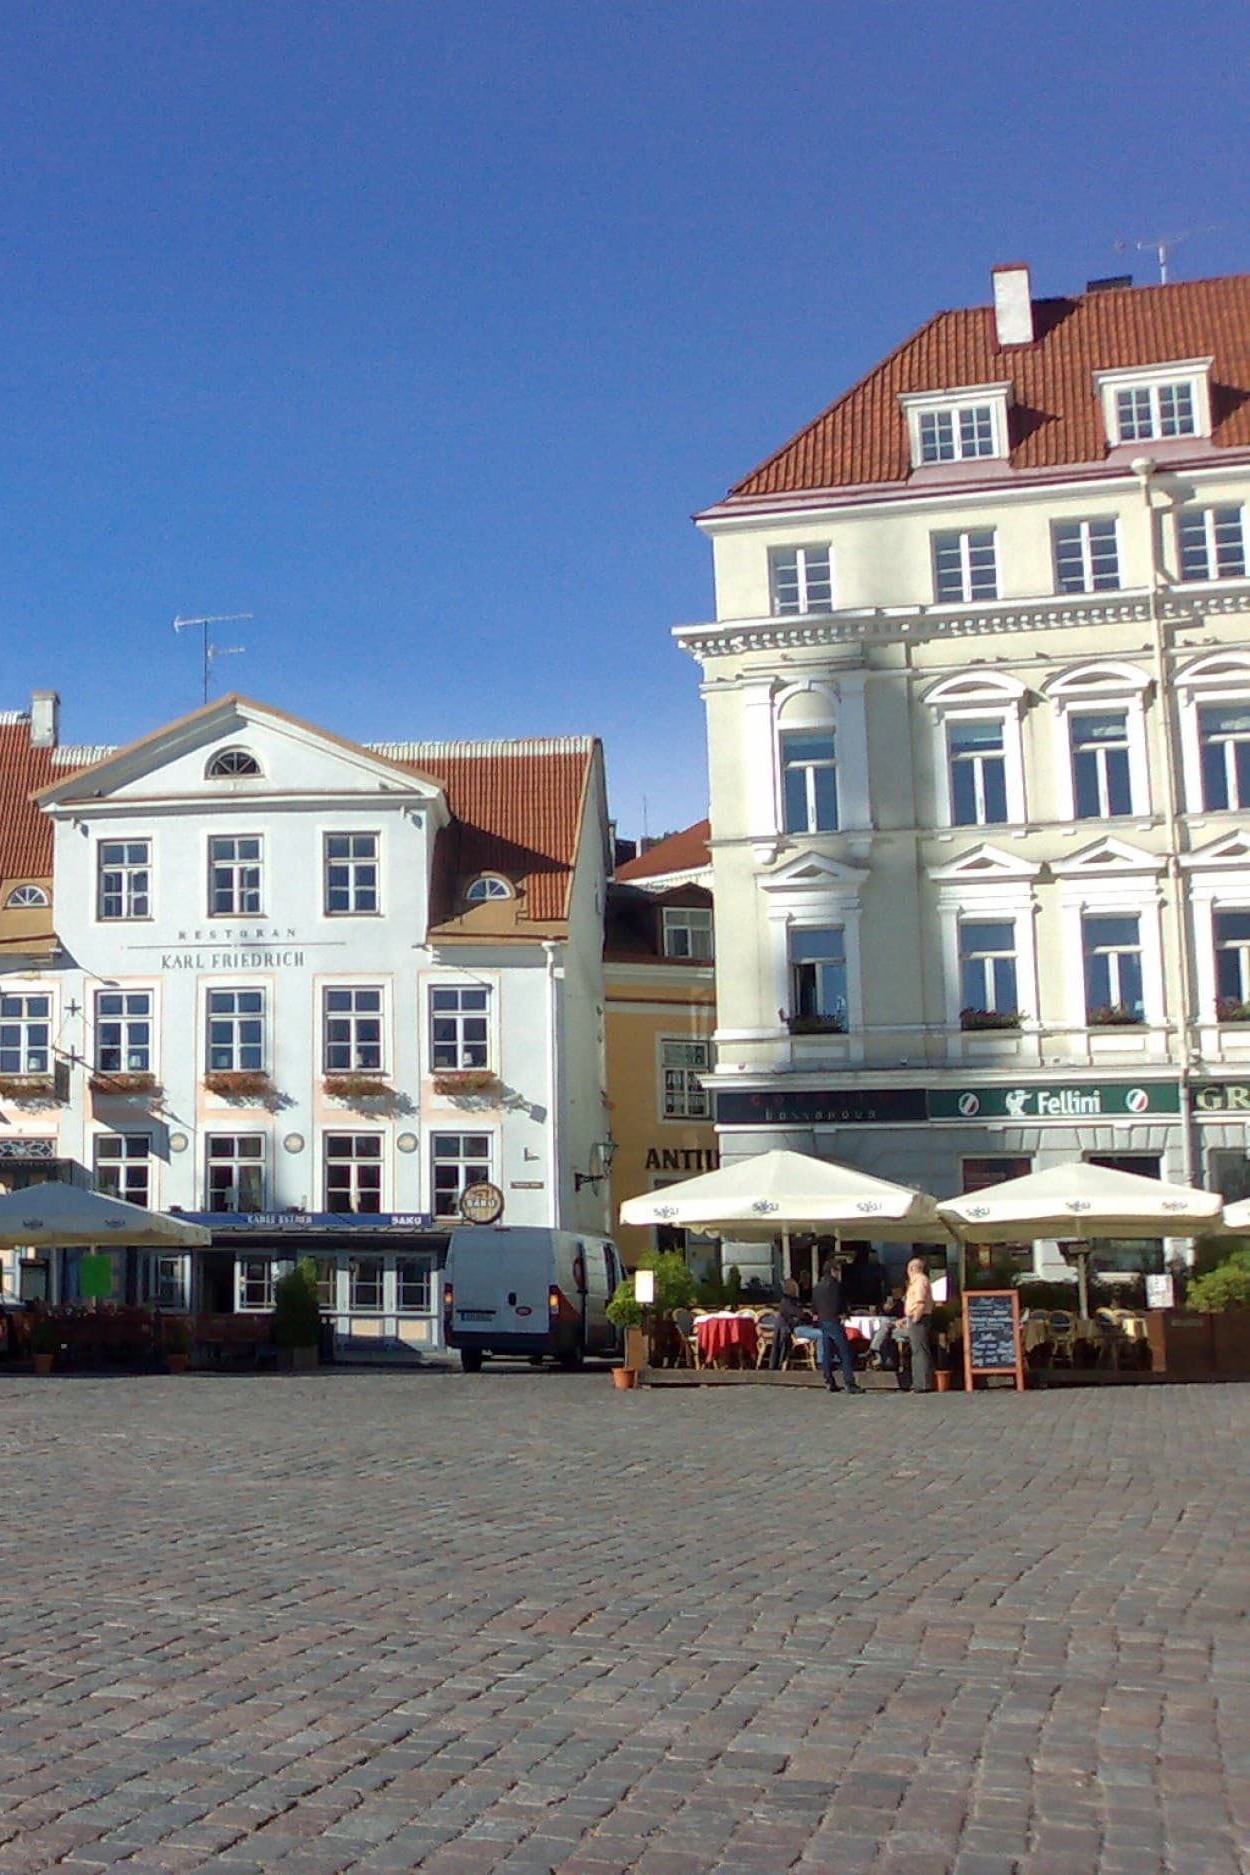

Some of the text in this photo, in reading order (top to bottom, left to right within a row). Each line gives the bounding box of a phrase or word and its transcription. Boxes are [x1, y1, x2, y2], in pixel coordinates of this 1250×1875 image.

[178, 929, 296, 940] RESTORAN
[161, 951, 304, 969] KARL FRIEDRICH
[1038, 1089, 1101, 1115] Fellini
[391, 1213, 422, 1225] SAKU
